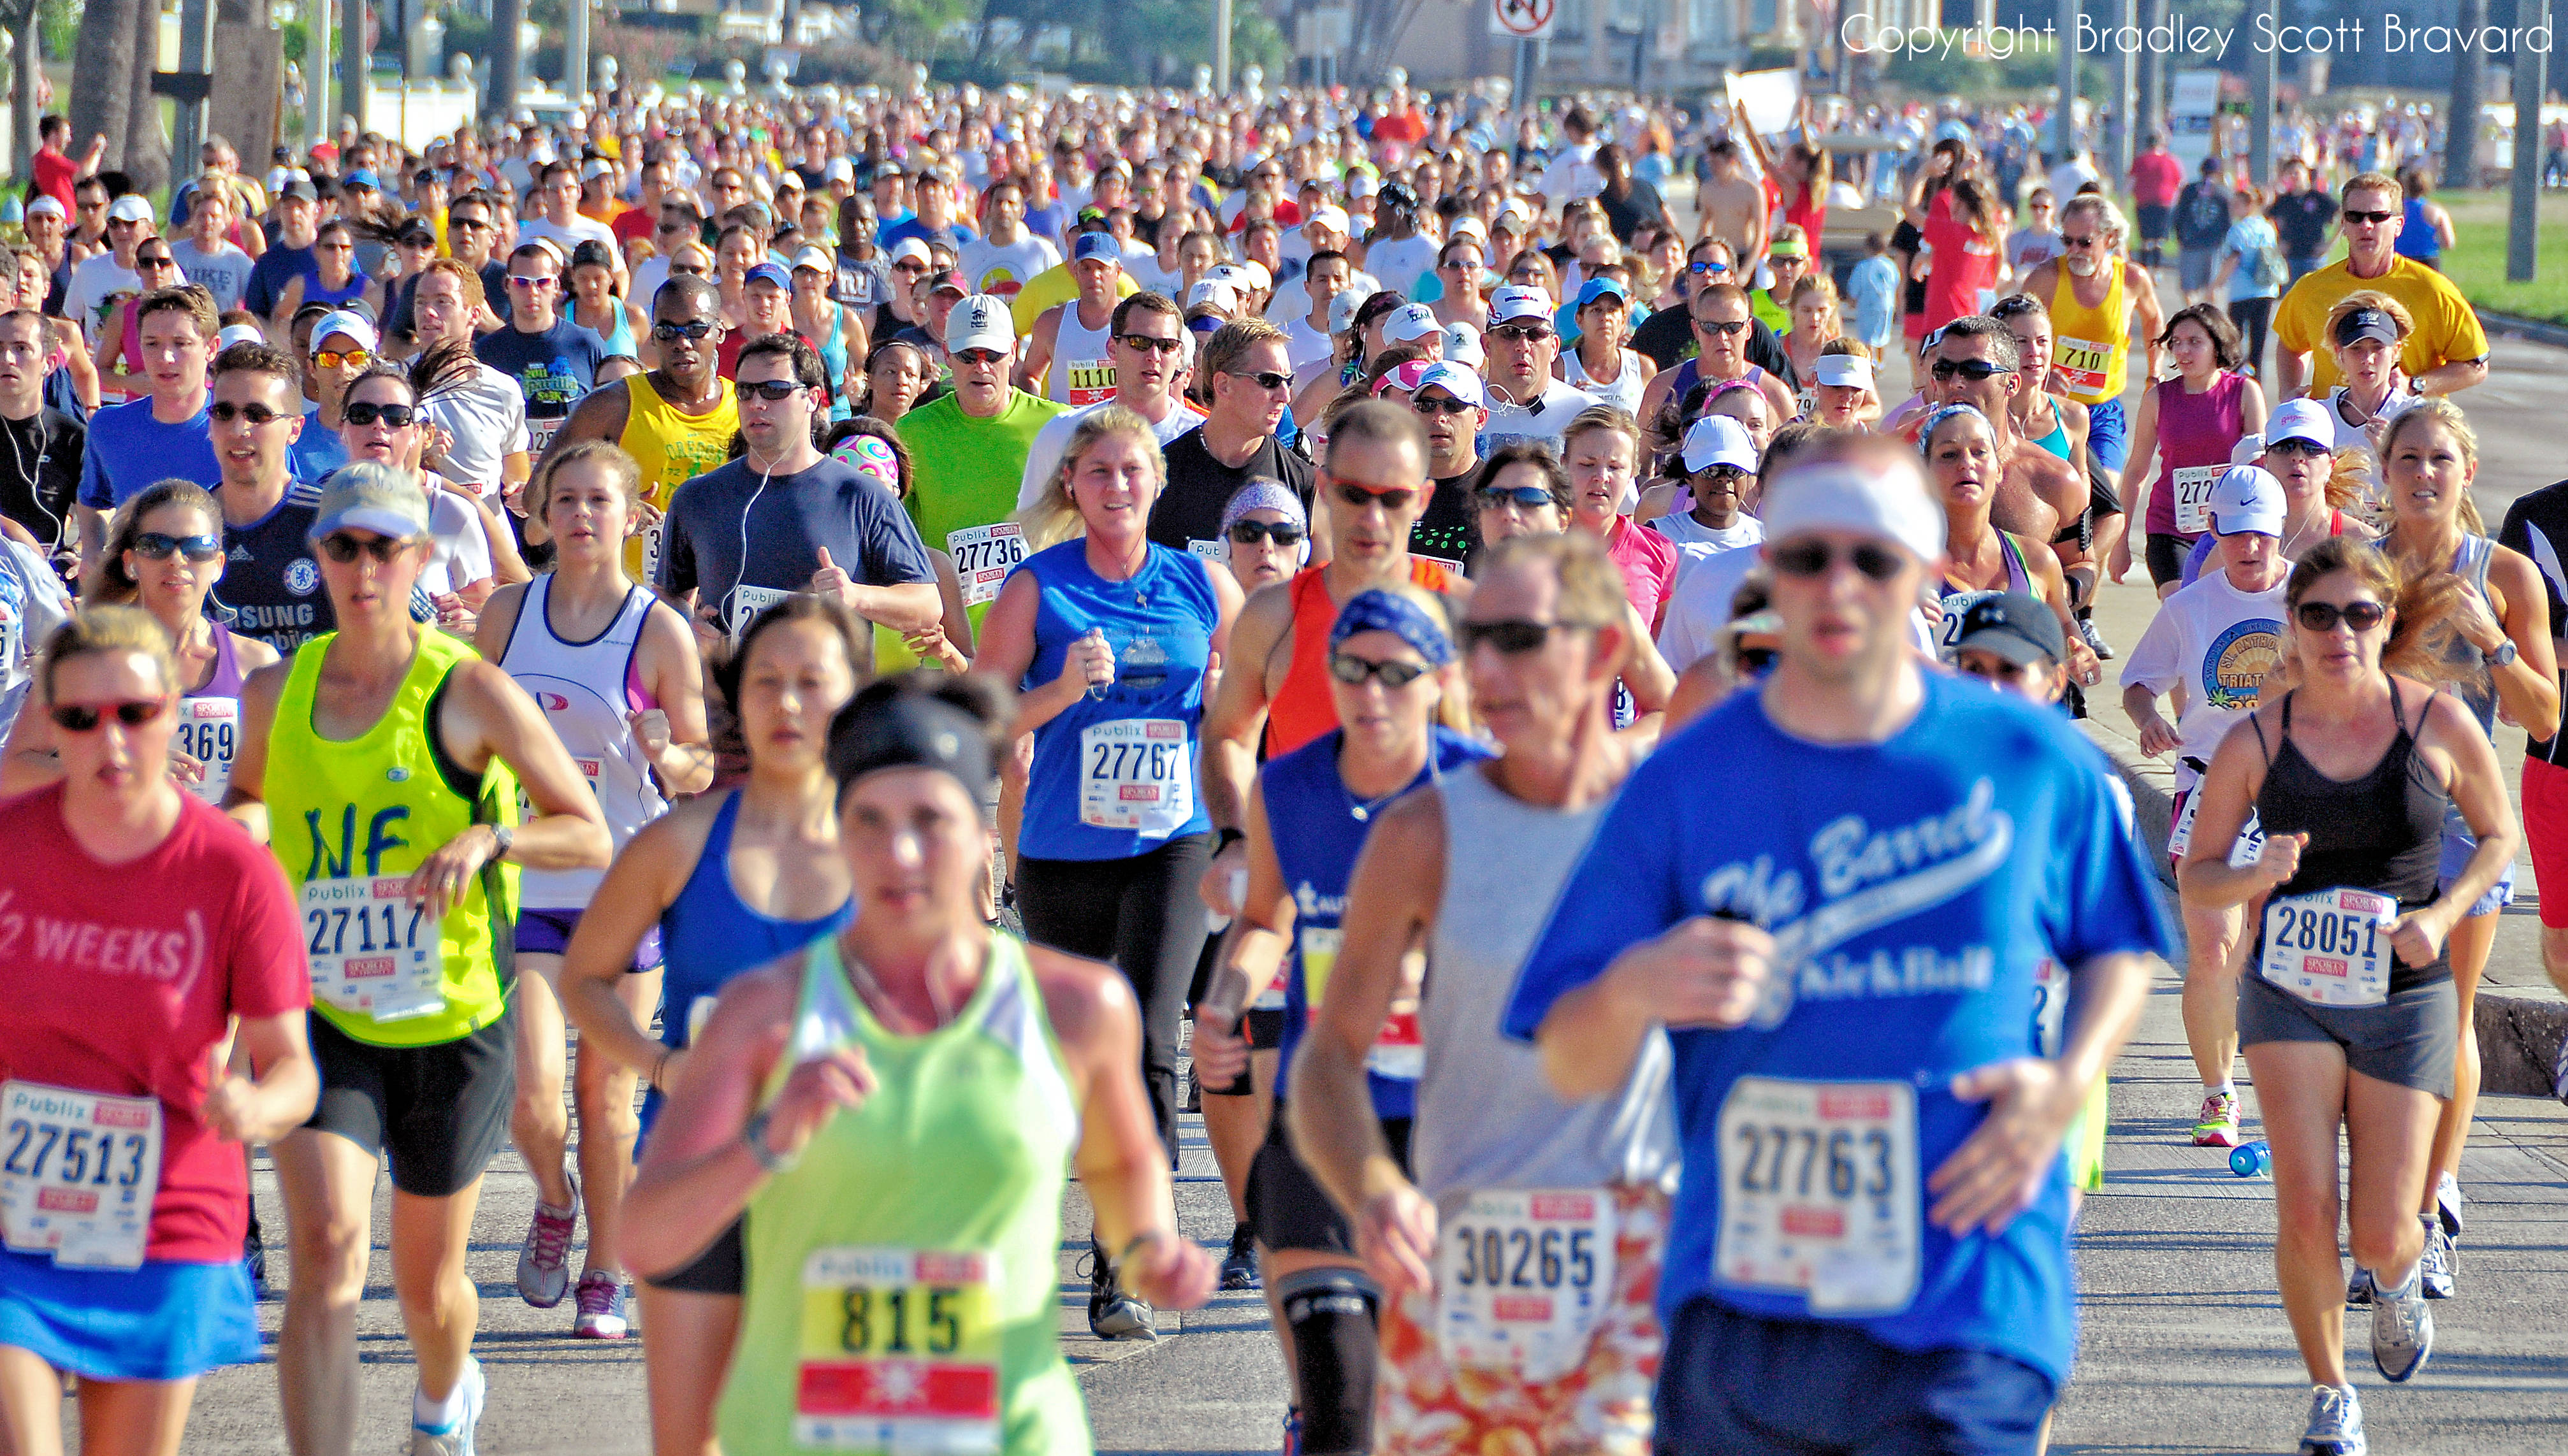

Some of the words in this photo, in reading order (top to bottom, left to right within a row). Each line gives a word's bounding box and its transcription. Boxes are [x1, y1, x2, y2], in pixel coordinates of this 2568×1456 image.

[2064, 347, 2100, 370] 710
[1074, 368, 1117, 388] 1110
[954, 530, 987, 544] Publix
[955, 538, 1022, 573] 27736
[2235, 635, 2279, 654] ANTHO
[2220, 674, 2267, 688] TRIAT
[1093, 725, 1141, 737] Publix
[1092, 743, 1181, 779] 27767
[308, 885, 366, 902] Publix
[2343, 894, 2382, 908] SPORTS
[308, 904, 425, 955] 27117
[2275, 906, 2377, 958] 28051
[34, 910, 205, 996] WEEKS)
[2306, 958, 2345, 970] SPORTS
[4, 1118, 146, 1186] 27513
[1737, 1123, 1893, 1199] 27763
[1457, 1227, 1595, 1288] 30265
[842, 1286, 961, 1355] 815
